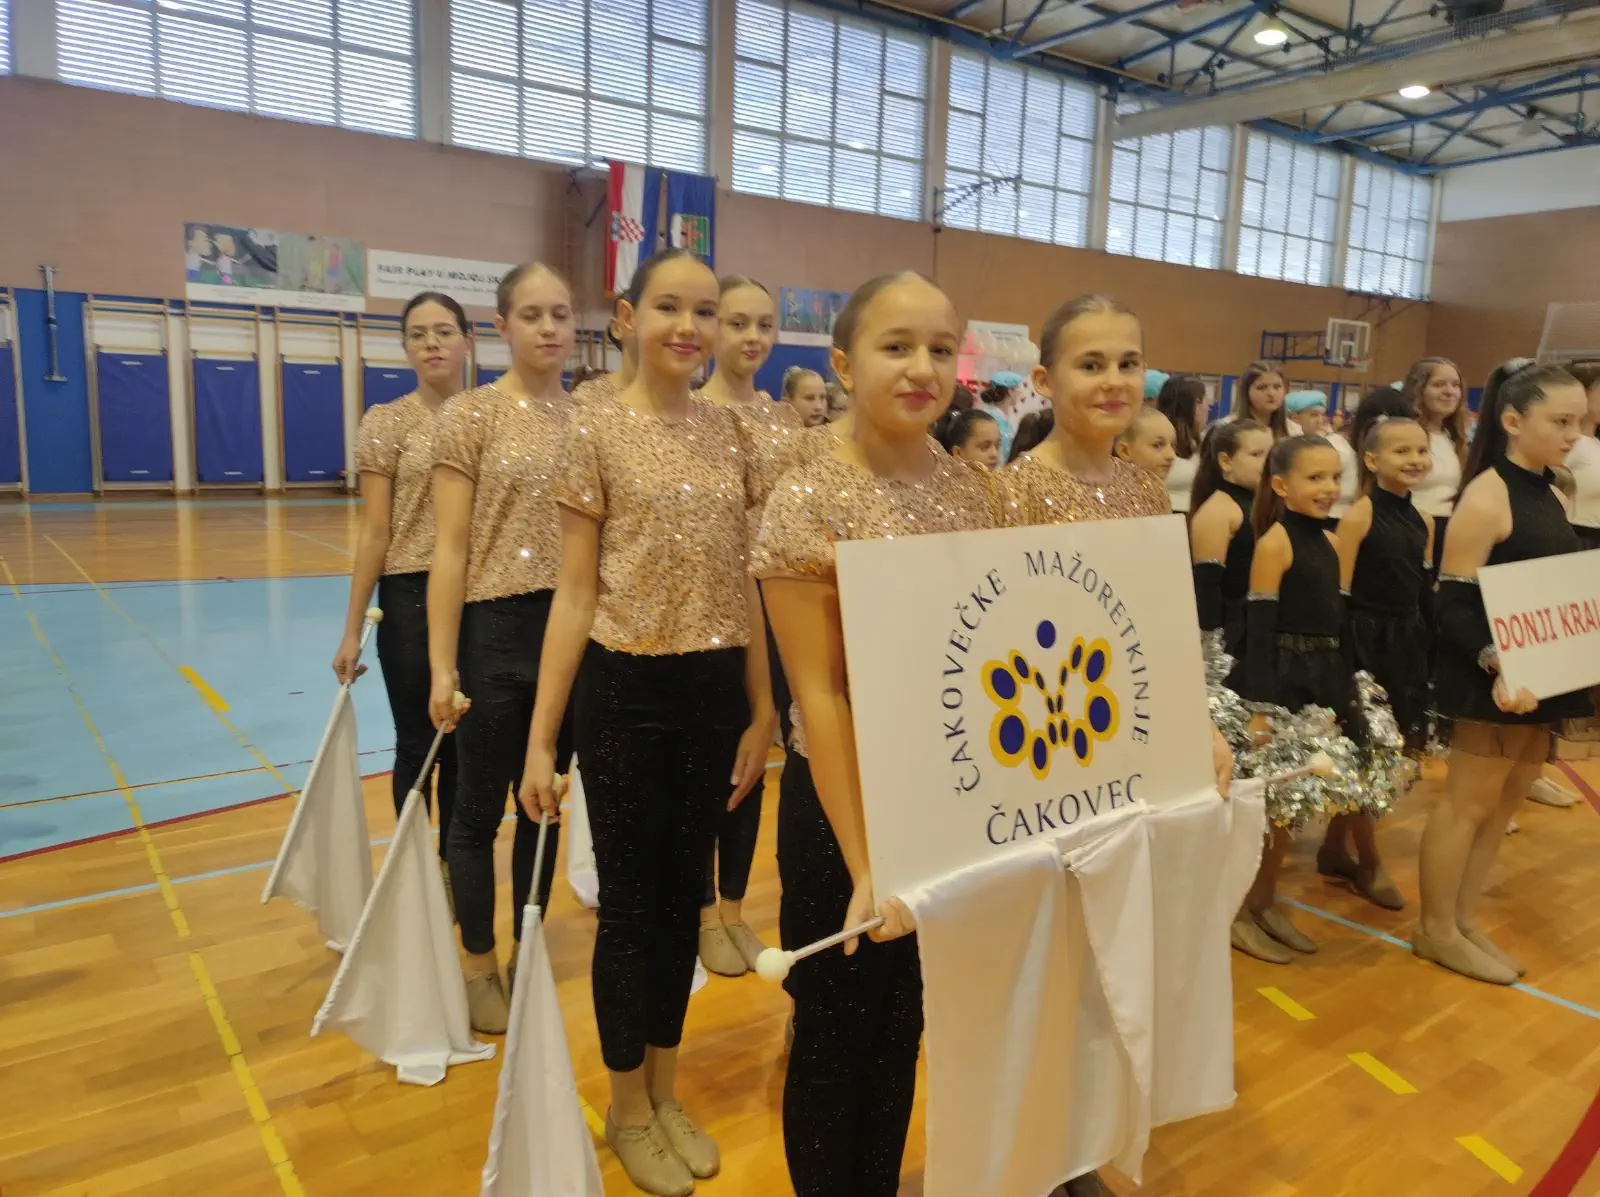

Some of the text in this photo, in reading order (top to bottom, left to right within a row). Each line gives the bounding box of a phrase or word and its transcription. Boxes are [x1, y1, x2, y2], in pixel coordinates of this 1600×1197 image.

[1494, 606, 1558, 652] DONJI
[940, 549, 1151, 796] ČAKOVEČKE MAŽORETKINJE
[986, 773, 1143, 846] ČAKOVEC
